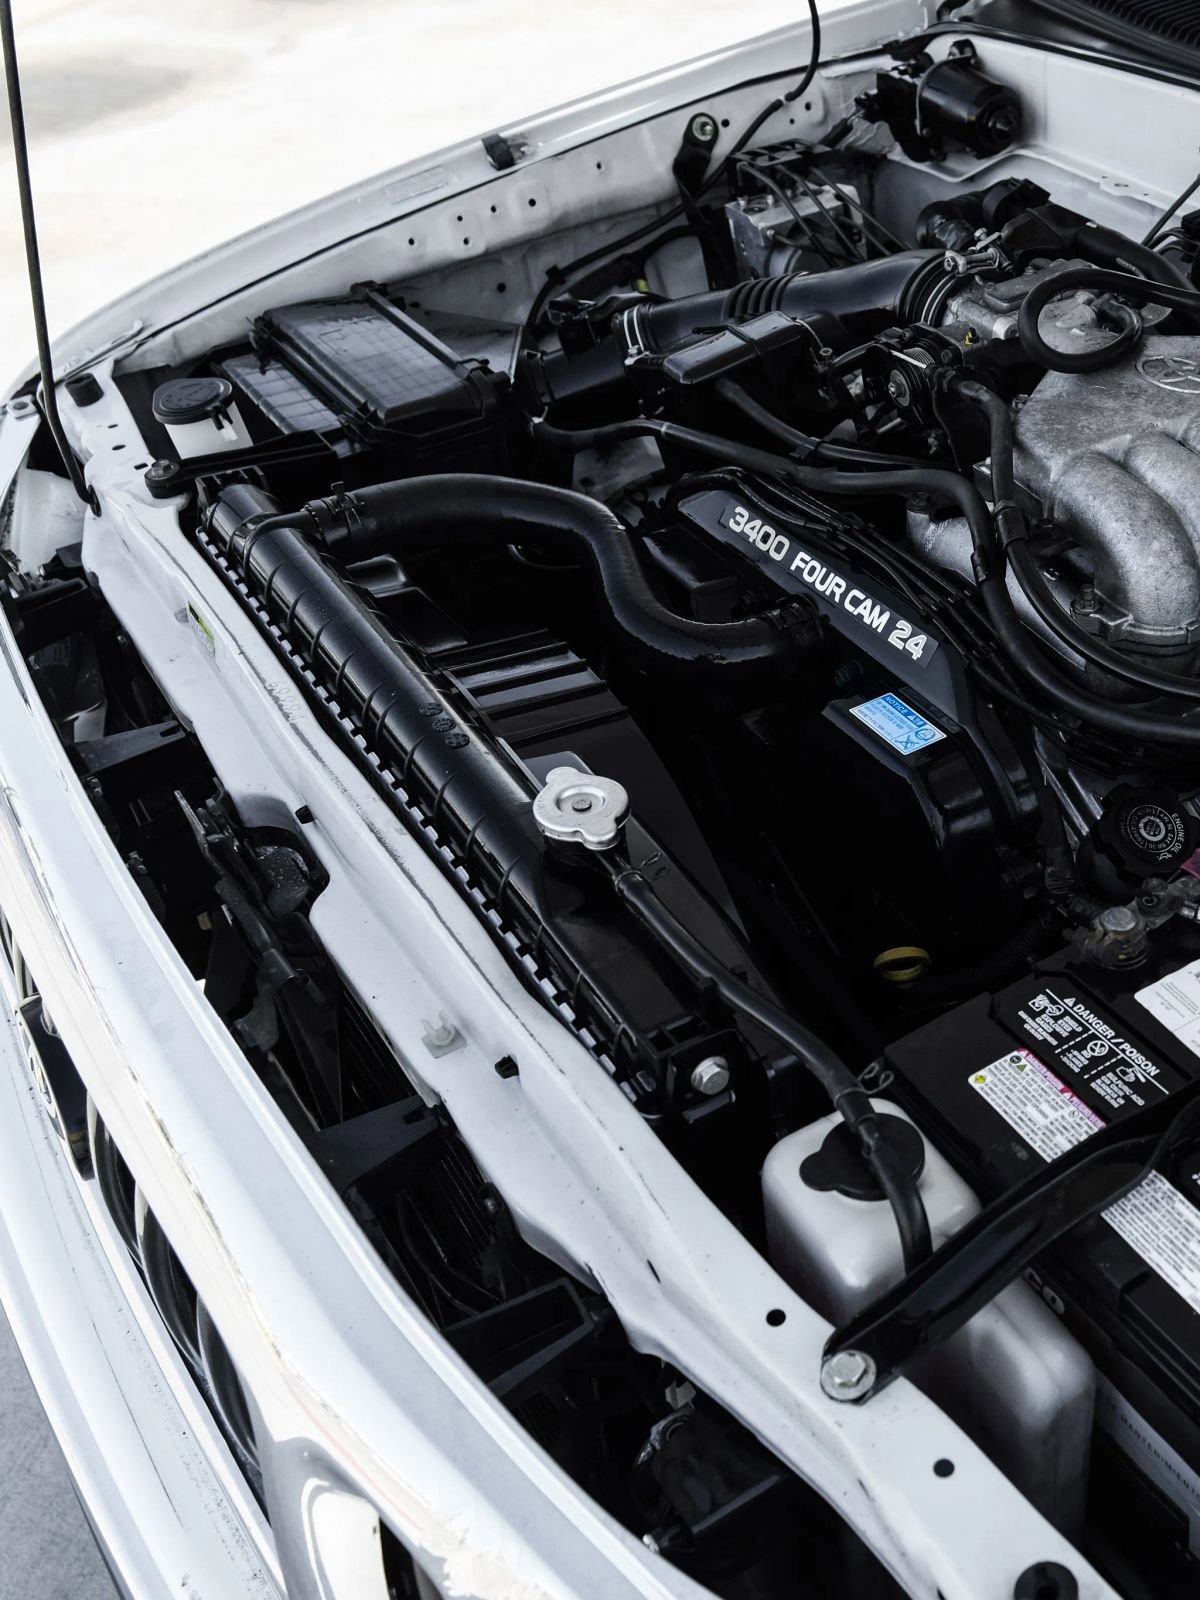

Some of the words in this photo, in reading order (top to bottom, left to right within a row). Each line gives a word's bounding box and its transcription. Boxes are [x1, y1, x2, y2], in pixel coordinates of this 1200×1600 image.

[728, 505, 790, 561] 3400
[790, 551, 847, 604] FOUR
[844, 589, 891, 633] CAM
[888, 622, 928, 661] 24
[885, 696, 908, 714] NOTICE
[1171, 813, 1185, 843] ENGINE
[1172, 842, 1182, 853] OIL
[1035, 1018, 1053, 1031] GASES
[1057, 1020, 1071, 1030] EYES
[1063, 1016, 1082, 1030] SHIELD
[1073, 1004, 1116, 1041] DANGER
[1119, 1042, 1160, 1077] POISON
